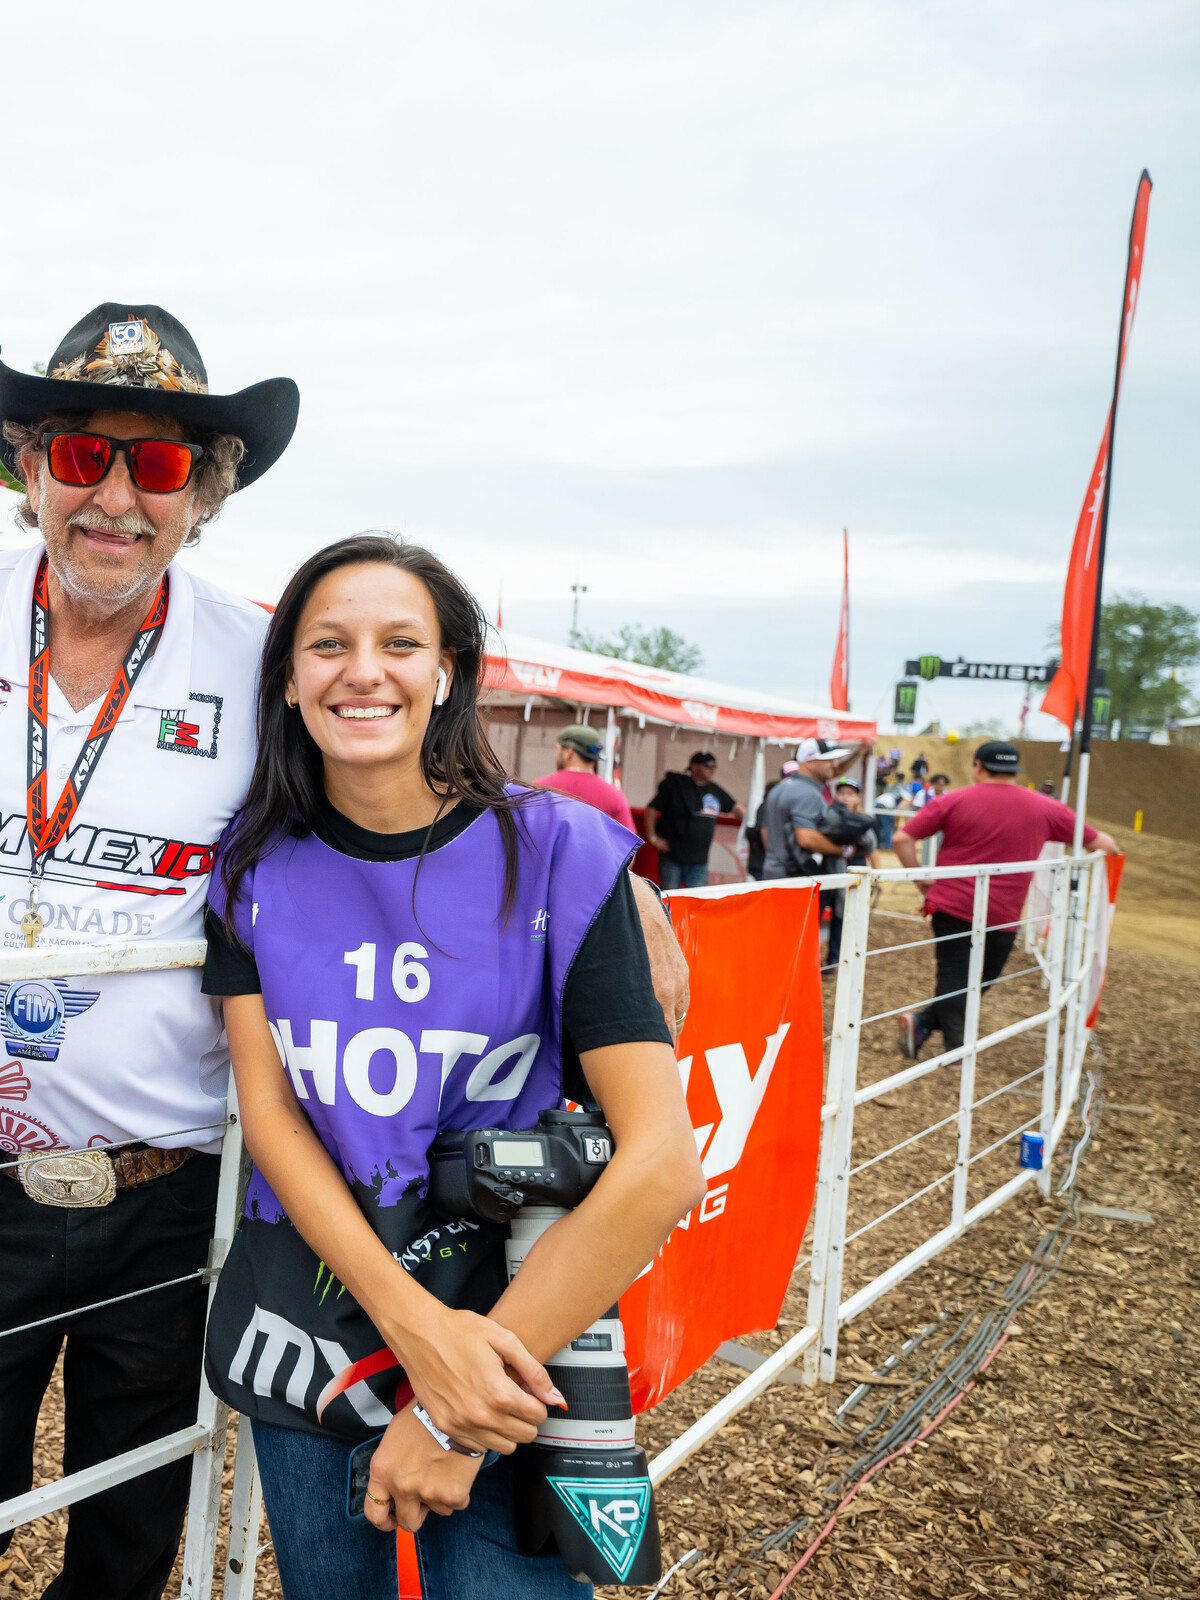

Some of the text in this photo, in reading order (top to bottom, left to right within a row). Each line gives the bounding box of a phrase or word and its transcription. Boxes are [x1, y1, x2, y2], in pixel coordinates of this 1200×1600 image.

[951, 663, 1047, 681] FINISH
[7, 898, 155, 937] CONADE
[343, 941, 431, 1004] 16
[13, 994, 56, 1023] FIM
[16, 1048, 48, 1059] AMERICA
